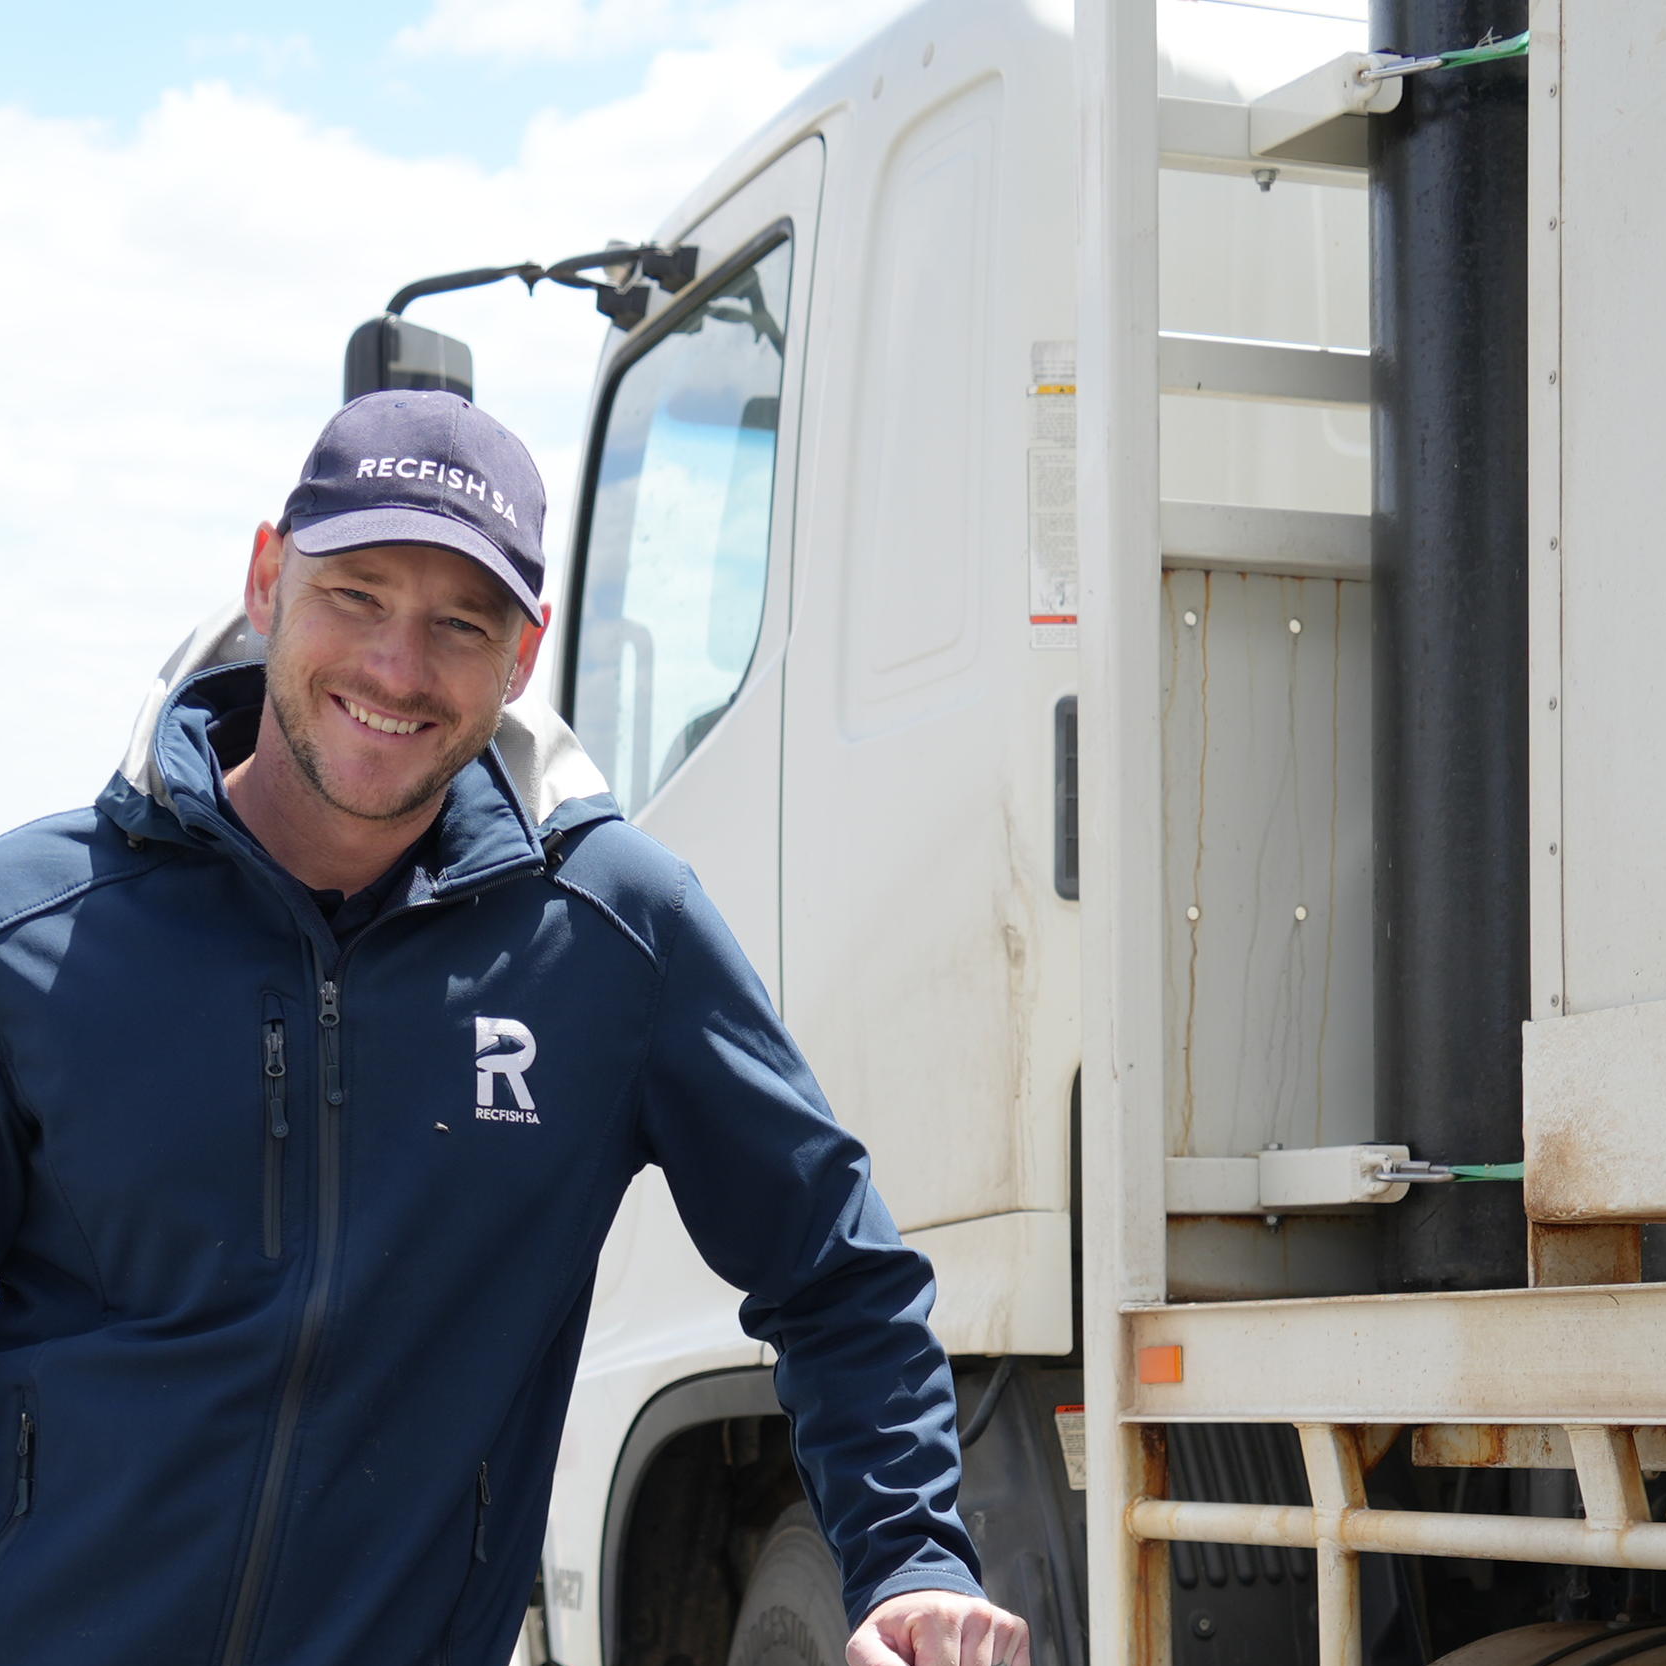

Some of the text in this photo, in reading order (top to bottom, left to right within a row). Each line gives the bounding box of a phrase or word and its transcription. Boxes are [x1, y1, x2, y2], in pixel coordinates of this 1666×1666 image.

[356, 457, 518, 528] RECFISH SA
[475, 1107, 541, 1125] RECFISH SA
